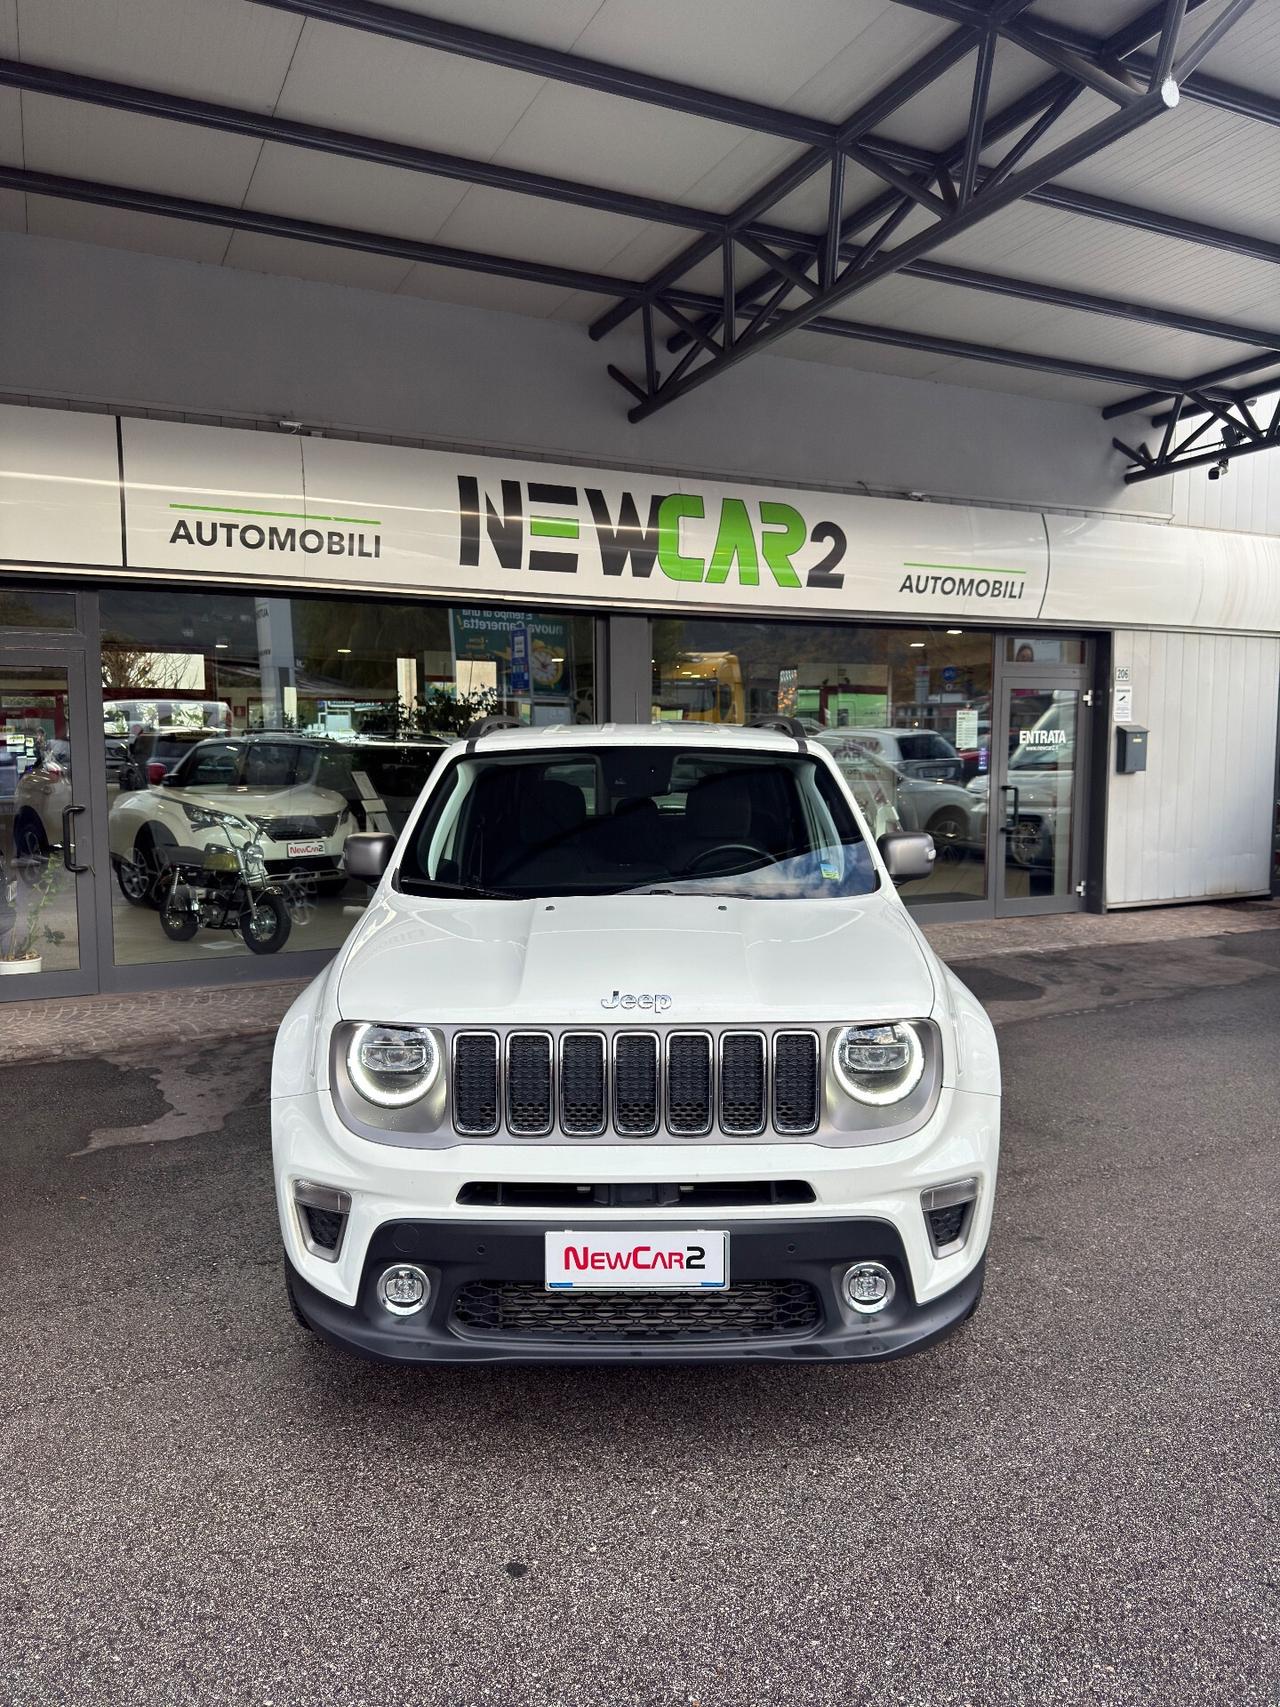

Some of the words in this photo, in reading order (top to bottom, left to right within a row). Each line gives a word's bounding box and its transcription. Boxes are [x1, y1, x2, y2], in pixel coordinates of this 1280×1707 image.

[169, 518, 381, 559] AUTOMOBILI
[899, 574, 1025, 599] AUTOMOBILI
[1117, 668, 1129, 679] 206
[1019, 730, 1066, 744] ENTRATA
[600, 990, 673, 1014] Jeep
